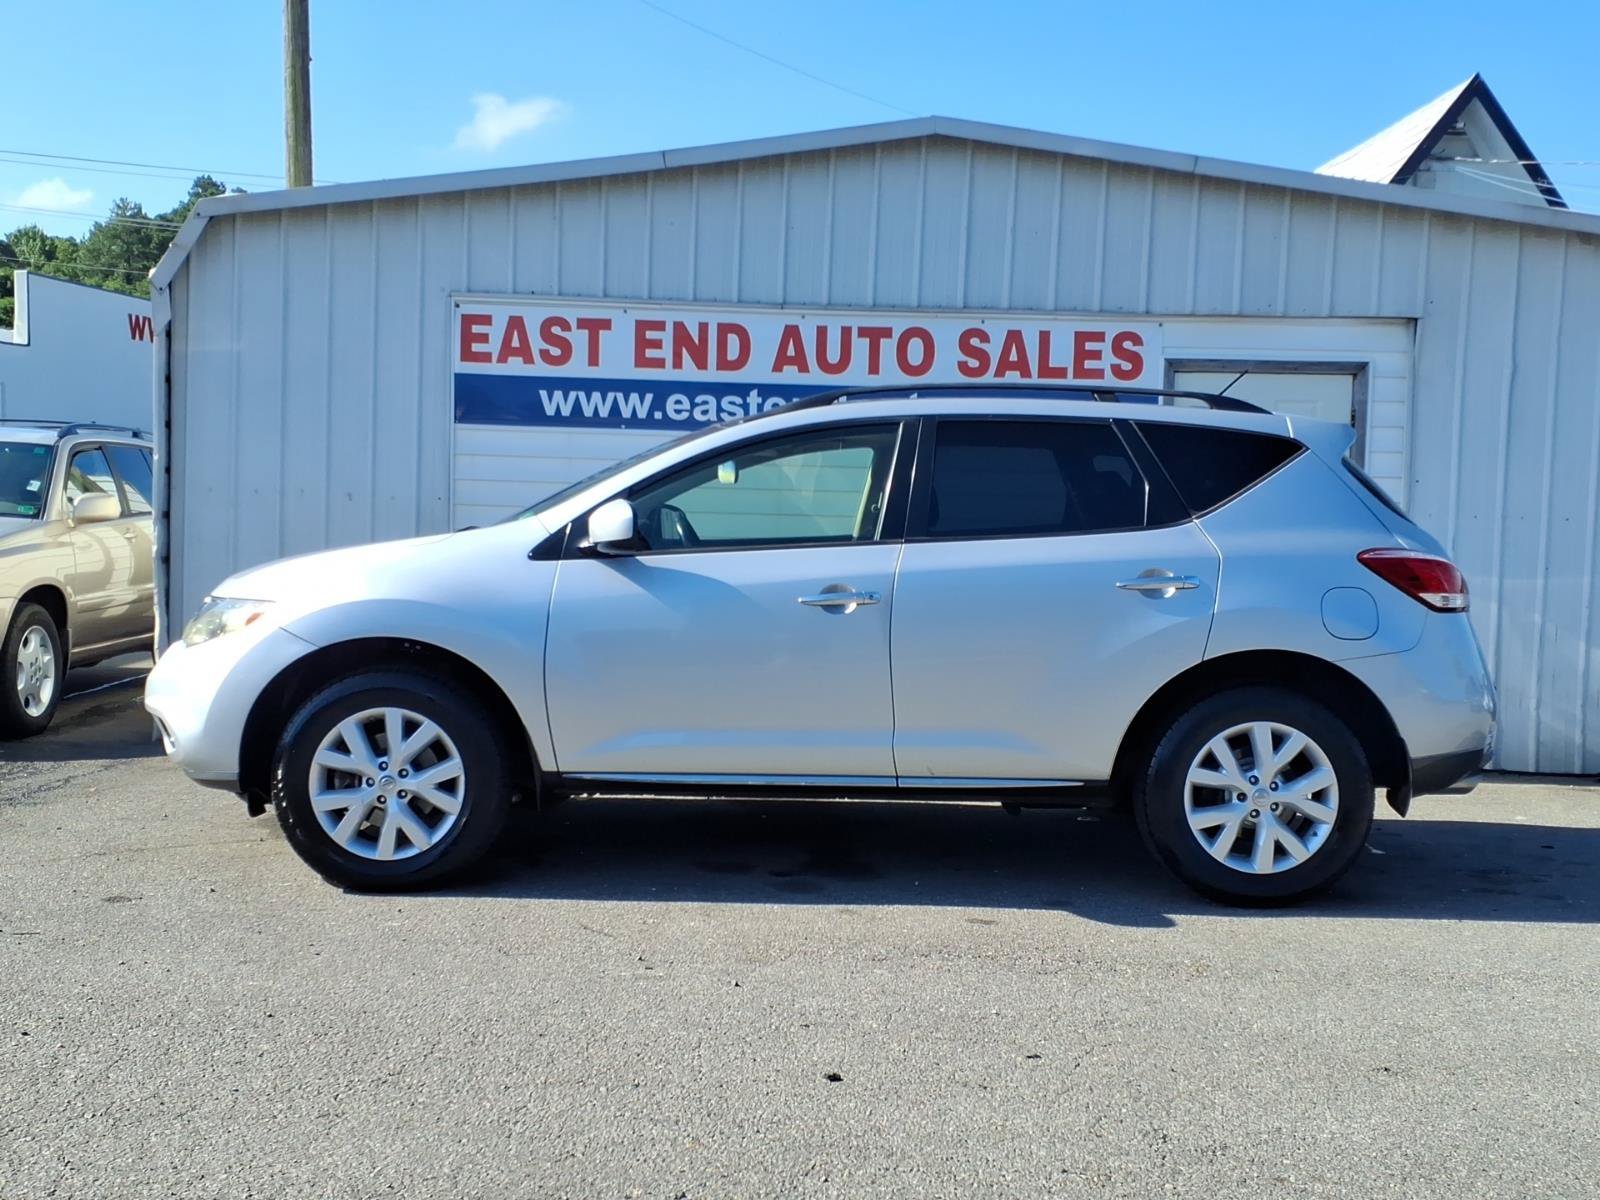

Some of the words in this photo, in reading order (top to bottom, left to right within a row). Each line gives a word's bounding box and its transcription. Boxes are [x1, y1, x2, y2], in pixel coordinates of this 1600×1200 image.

[460, 314, 612, 367] EAST
[634, 319, 752, 372] END
[771, 324, 936, 377] AUTO
[956, 327, 1145, 382] SALES
